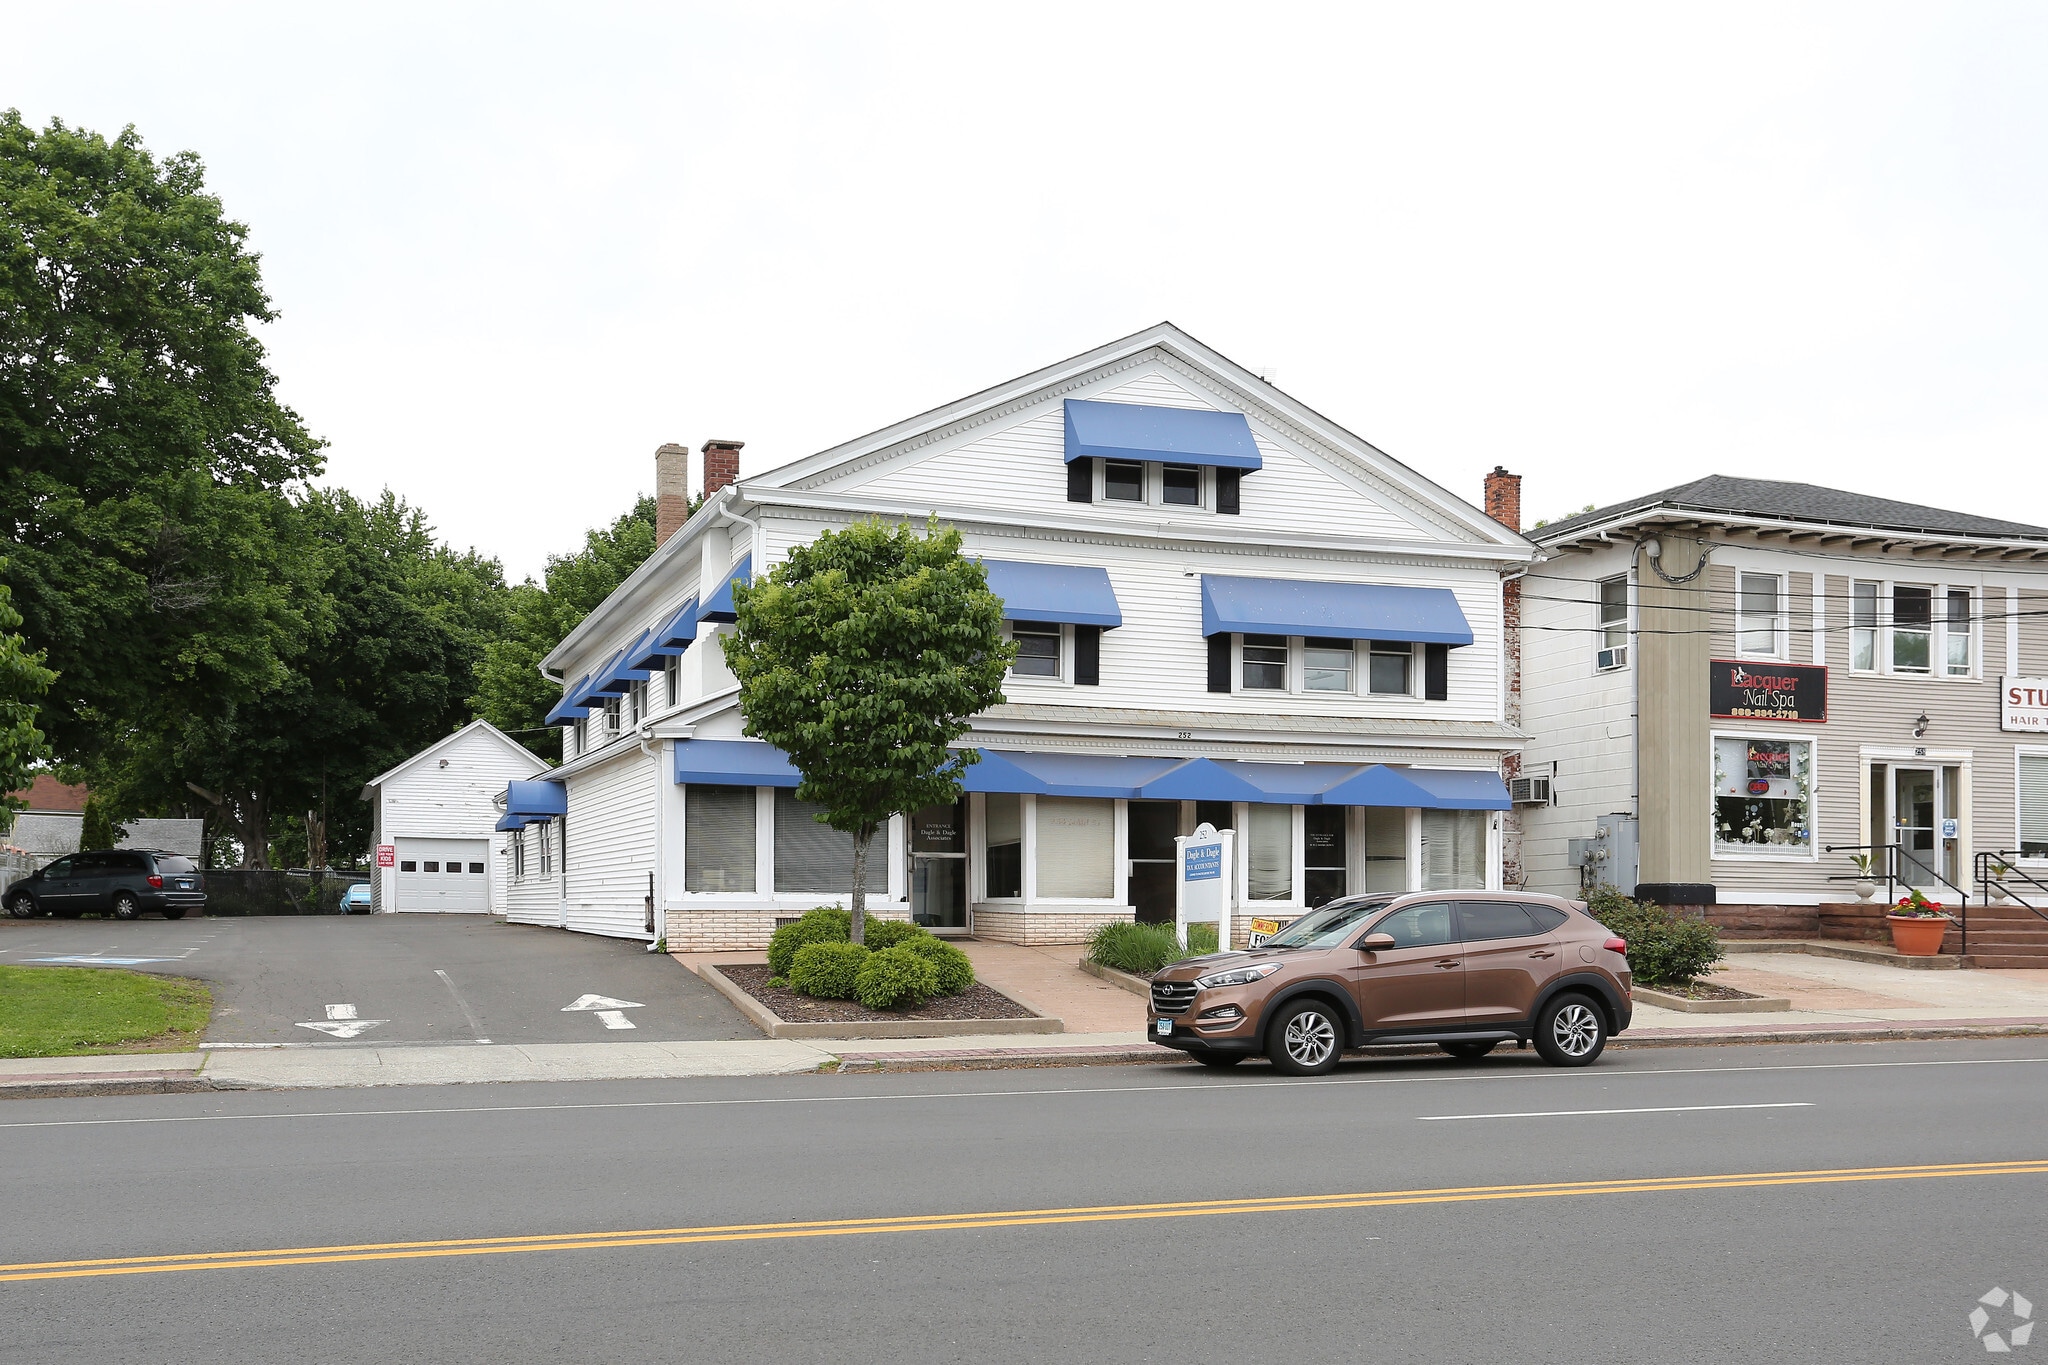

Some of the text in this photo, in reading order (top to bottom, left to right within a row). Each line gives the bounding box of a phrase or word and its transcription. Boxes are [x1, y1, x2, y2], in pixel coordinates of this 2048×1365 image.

[1731, 668, 1799, 695] Lacquer
[1743, 688, 1795, 711] Nail Spa
[2010, 715, 2039, 726] HAIR
[1178, 731, 1192, 739] 252
[1747, 747, 1790, 764] Lacquer
[1186, 846, 1220, 861] Dagle & Dagle
